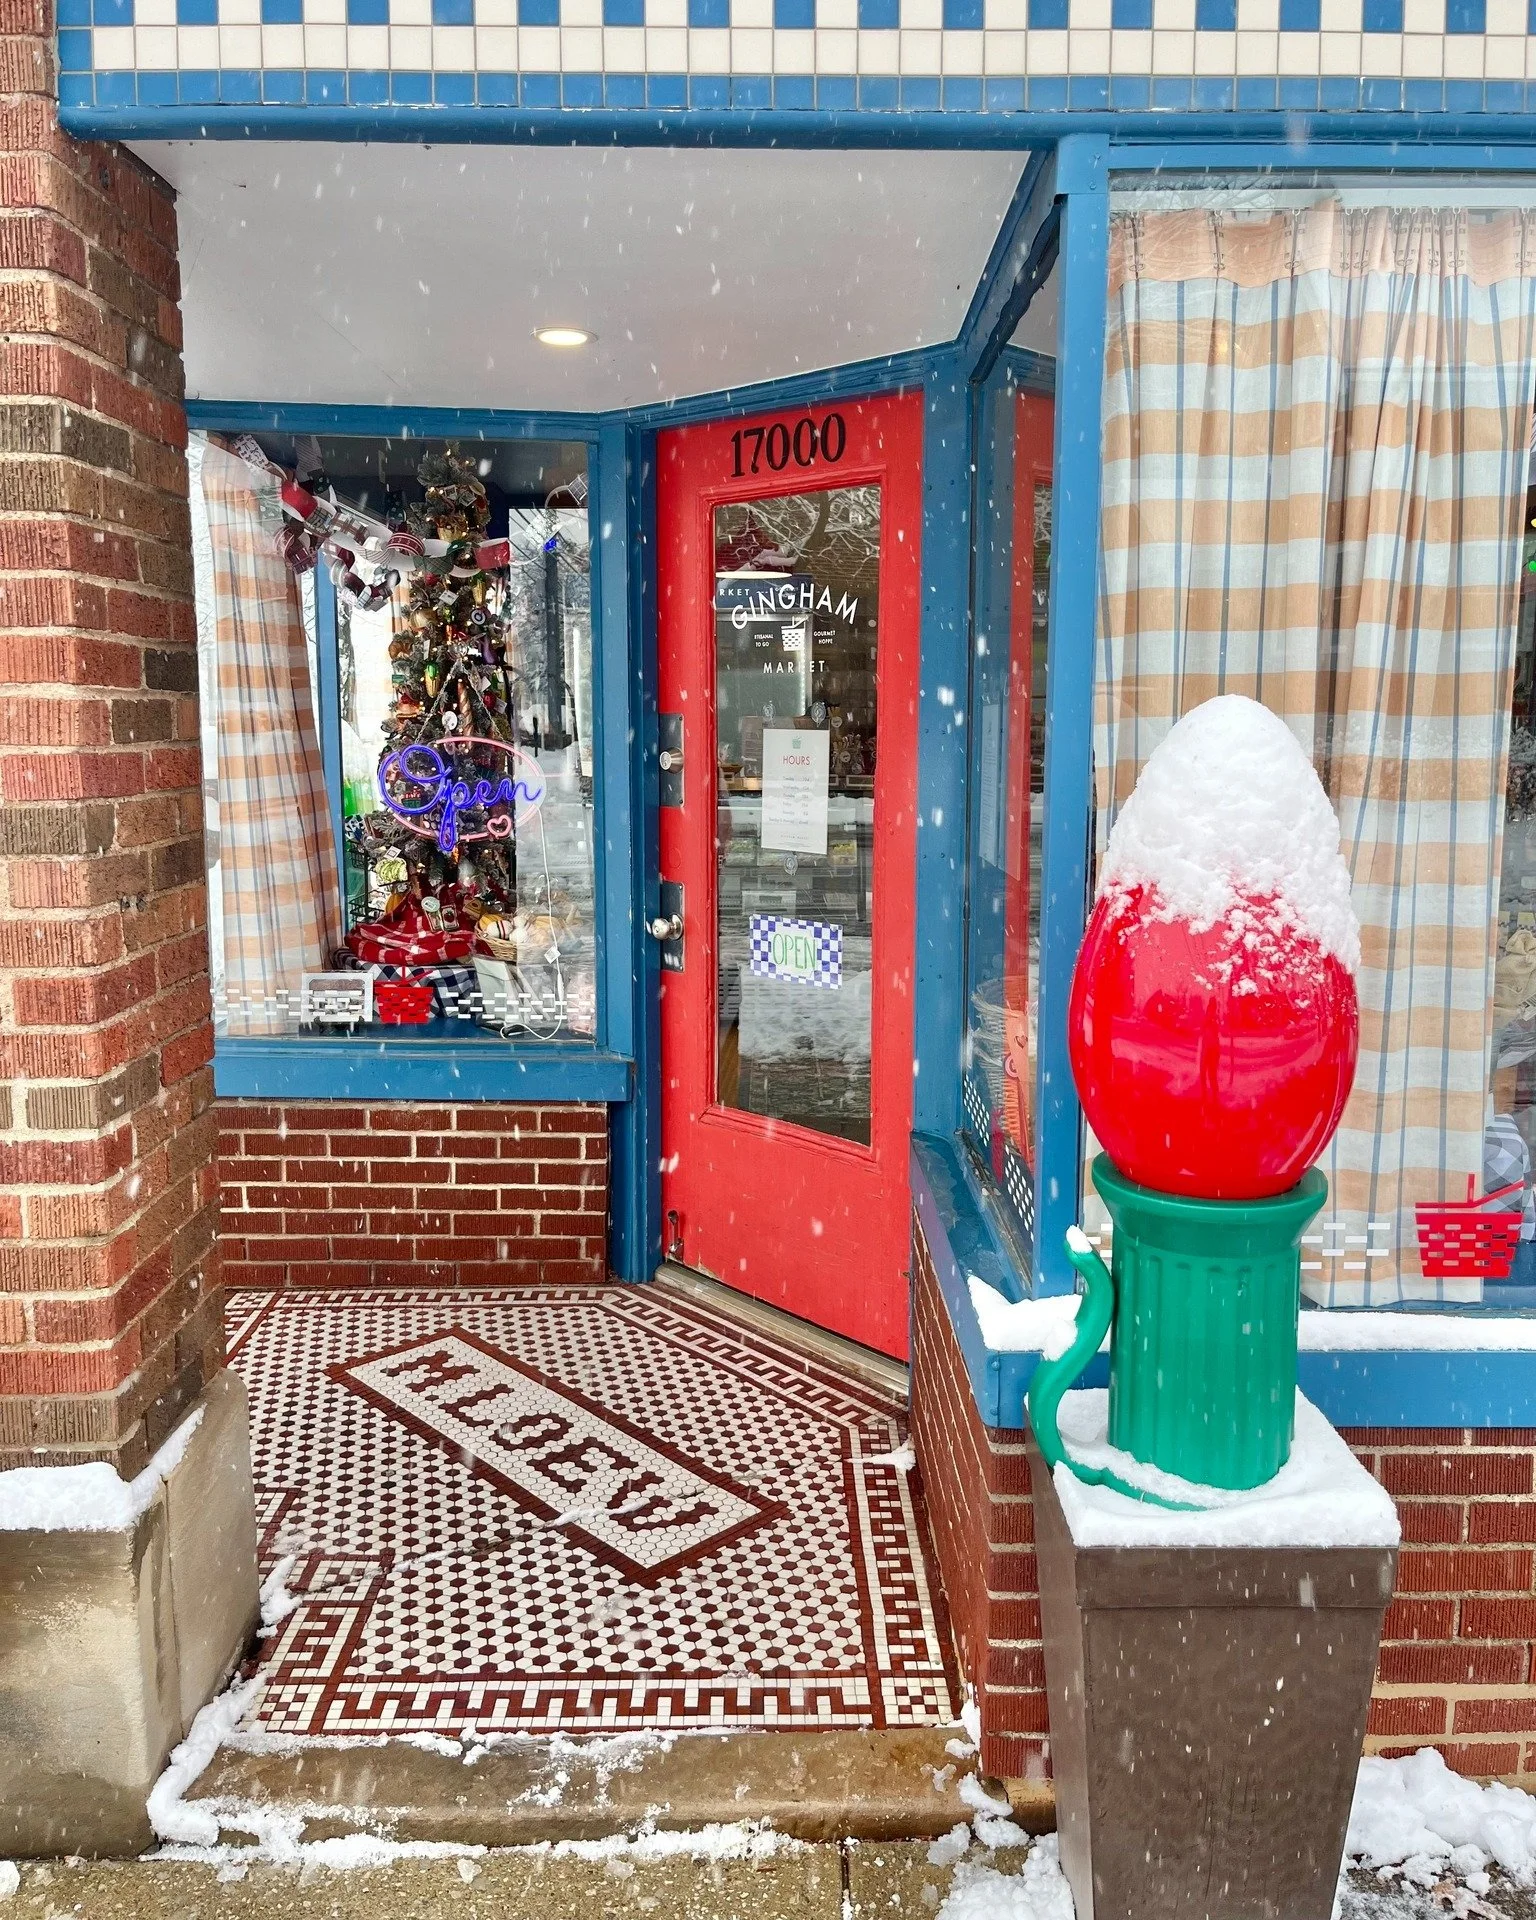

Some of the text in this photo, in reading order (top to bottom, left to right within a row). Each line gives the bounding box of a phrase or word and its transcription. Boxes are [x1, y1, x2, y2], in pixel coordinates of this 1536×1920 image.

[730, 413, 846, 477] 17000
[732, 583, 859, 629] GINGHAM
[763, 660, 825, 674] MARET
[782, 755, 811, 766] HOURS
[377, 744, 543, 852] Open
[772, 933, 817, 970] OPEN
